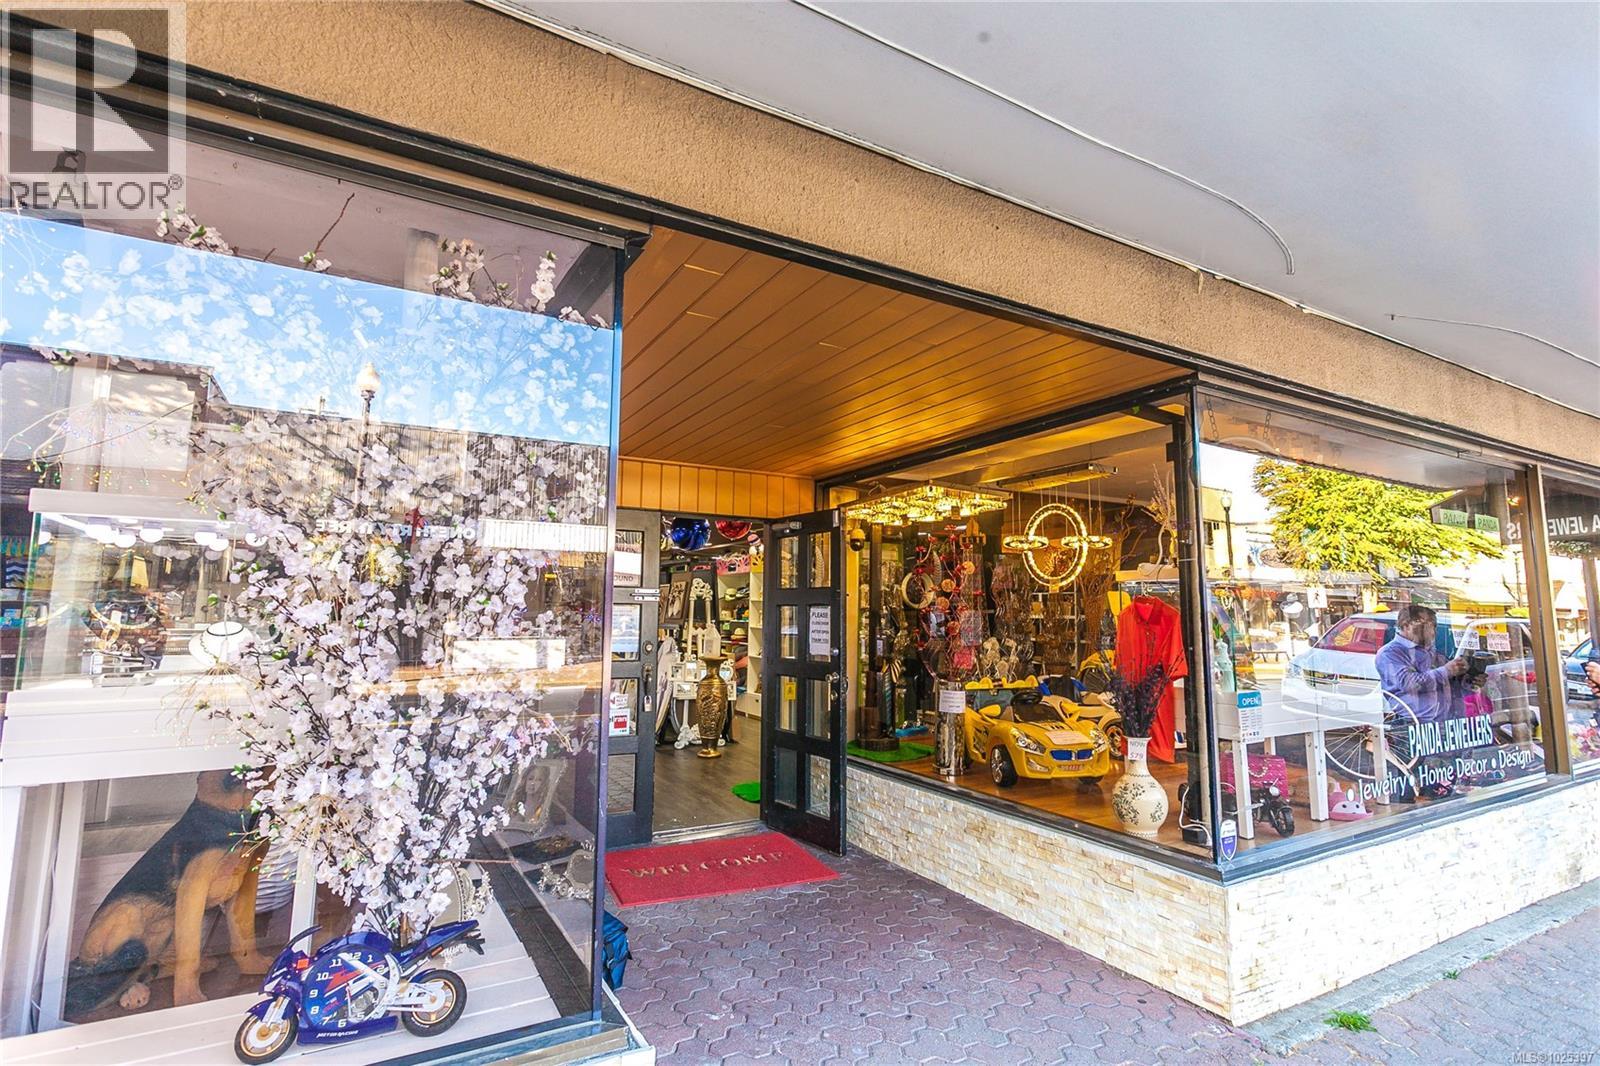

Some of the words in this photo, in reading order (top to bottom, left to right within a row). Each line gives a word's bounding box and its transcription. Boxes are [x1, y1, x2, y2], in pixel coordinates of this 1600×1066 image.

[1241, 697, 1260, 706] OPEN
[1408, 721, 1444, 758] PANDA
[1443, 714, 1493, 752] JEWELLERS
[1358, 771, 1407, 801] Jewelry
[1418, 765, 1454, 787] Home
[1456, 756, 1488, 777] Decor
[1498, 746, 1532, 769] Design
[329, 958, 342, 968] 11
[367, 954, 374, 963] 1
[316, 971, 329, 981] 10
[309, 989, 318, 998] 9
[310, 1005, 319, 1015] 8
[337, 1018, 348, 1028] 6
